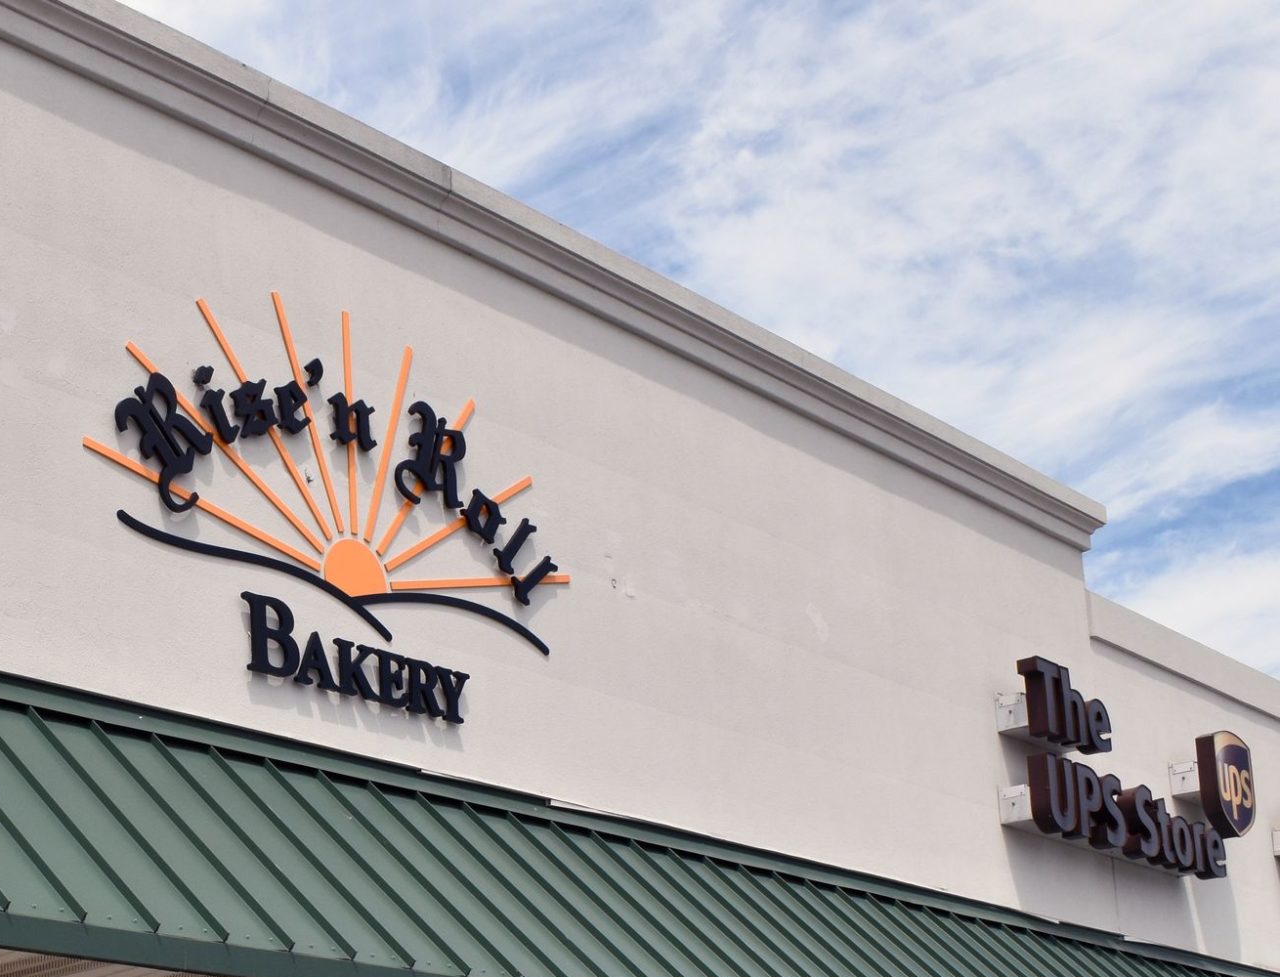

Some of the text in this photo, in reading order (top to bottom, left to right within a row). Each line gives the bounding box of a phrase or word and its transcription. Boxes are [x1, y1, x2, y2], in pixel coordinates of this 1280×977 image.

[395, 401, 559, 606] Roll
[240, 591, 470, 724] BAKERY
[1017, 655, 1112, 755] The
[1028, 752, 1227, 880] UPS Store
[1220, 762, 1253, 820] ups
